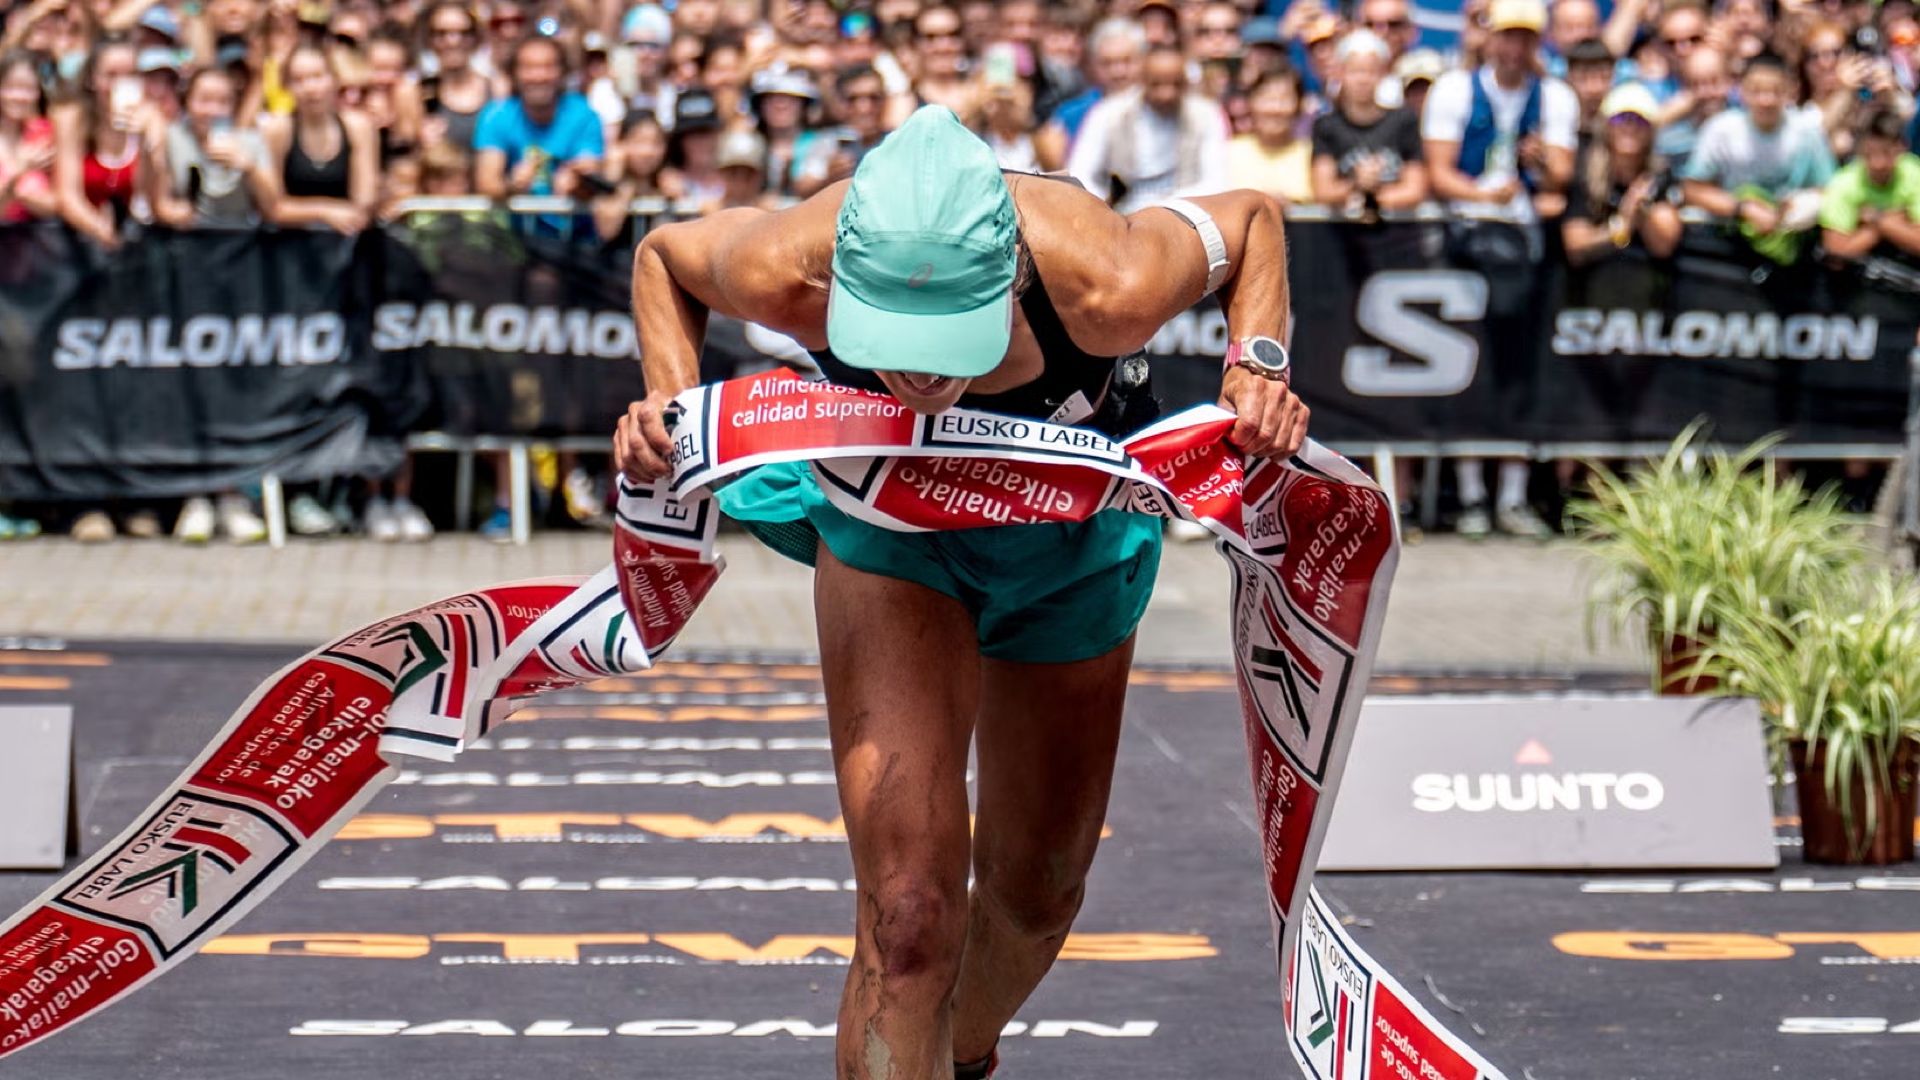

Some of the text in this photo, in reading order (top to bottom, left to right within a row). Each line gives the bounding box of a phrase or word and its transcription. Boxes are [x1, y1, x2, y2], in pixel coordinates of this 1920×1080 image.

[54, 314, 347, 370] SALOMO
[372, 302, 642, 360] SALOMO
[1553, 309, 1879, 361] SALOMON
[732, 400, 907, 428] calidad superior
[940, 414, 1119, 455] EUSKO LABEL
[670, 432, 700, 468] ABEL
[215, 671, 327, 783] calidad superior
[240, 686, 336, 778] Alimentos de
[264, 696, 372, 789] elikagaiak
[1412, 772, 1664, 812] SUUNTO
[72, 802, 194, 901] EUSKO LABEL
[0, 932, 71, 977] Alimento
[3, 921, 63, 958] calidad
[2, 938, 139, 1047] Goi-mailako
[1329, 944, 1364, 1000] EUSKO
[1375, 1015, 1420, 1065] superior
